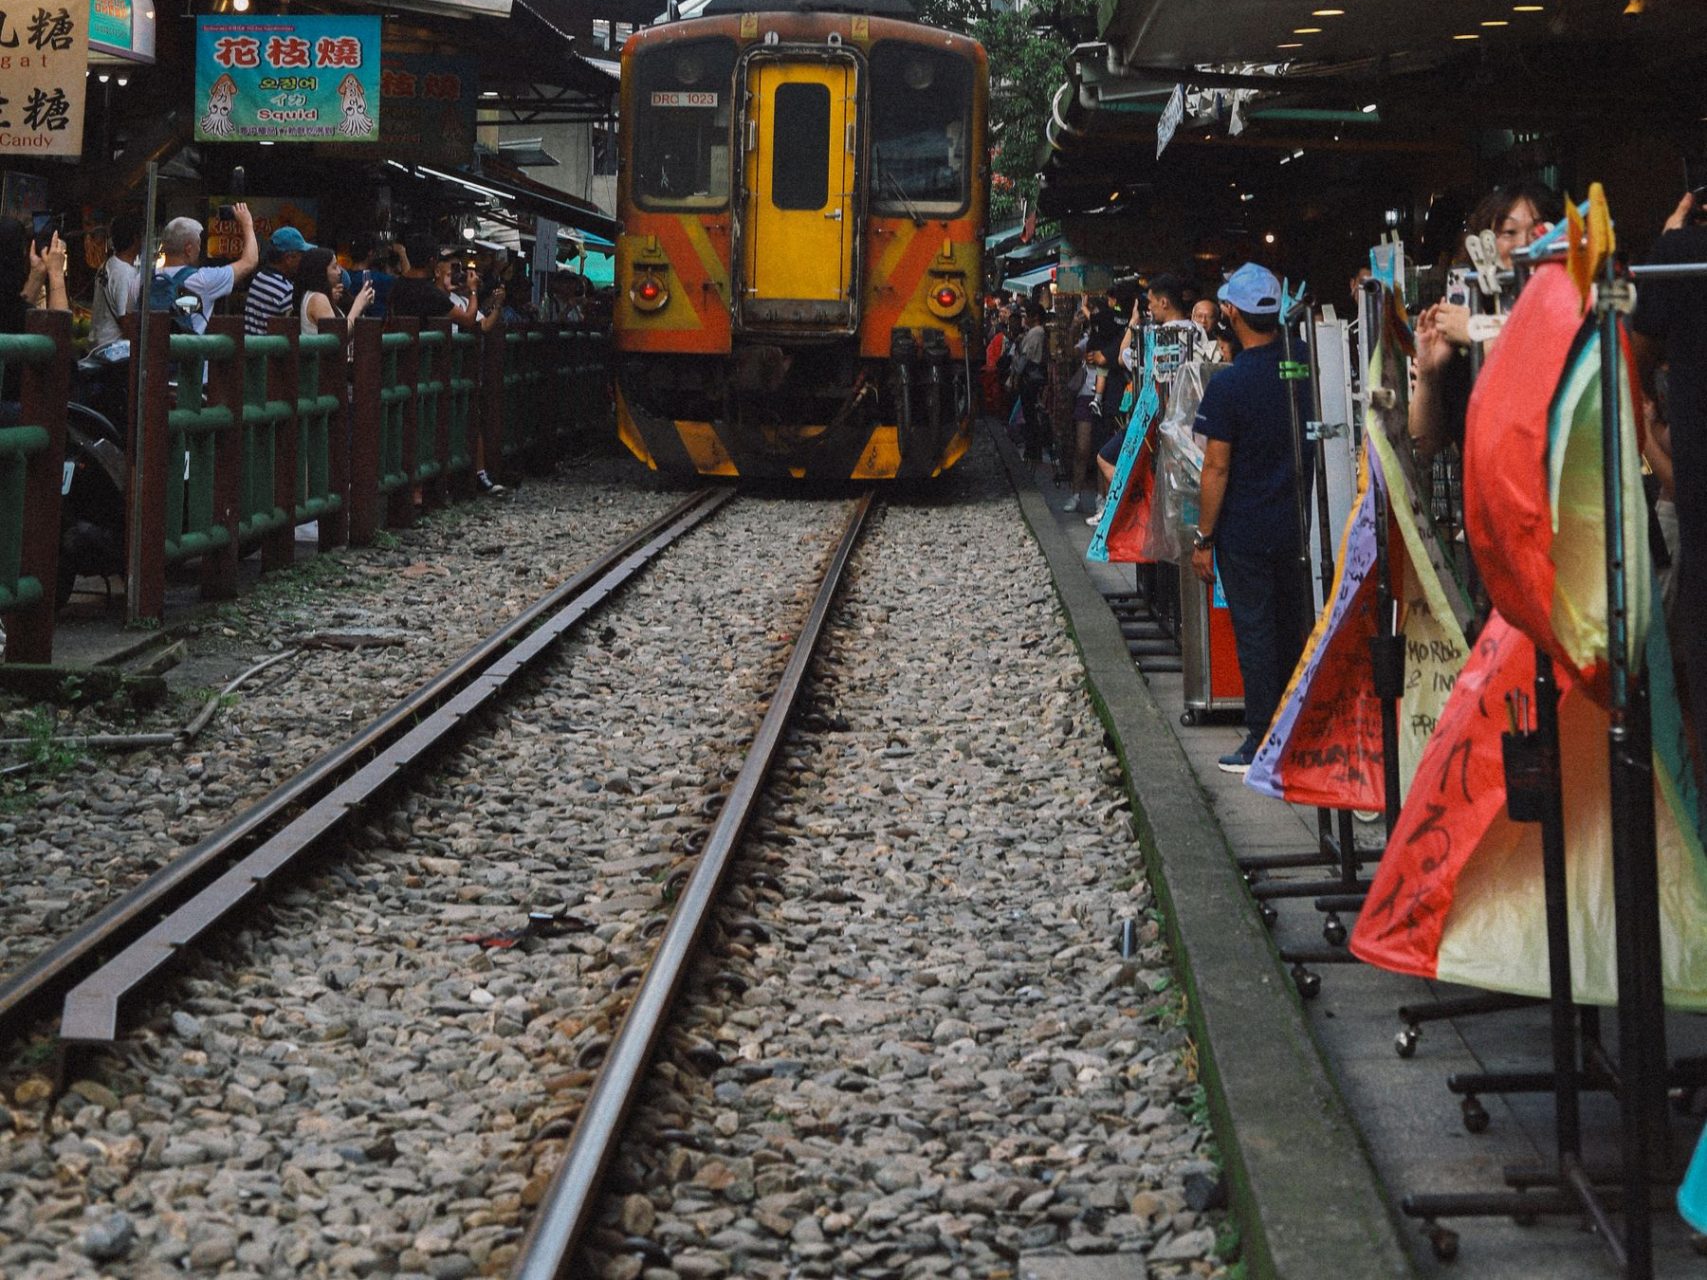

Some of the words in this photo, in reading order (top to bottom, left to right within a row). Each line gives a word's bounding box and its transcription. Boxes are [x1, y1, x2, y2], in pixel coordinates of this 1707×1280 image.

[215, 36, 362, 68] 花枝燒
[687, 93, 714, 105] 1023
[258, 108, 317, 121] Squid
[0, 132, 53, 148] Candy
